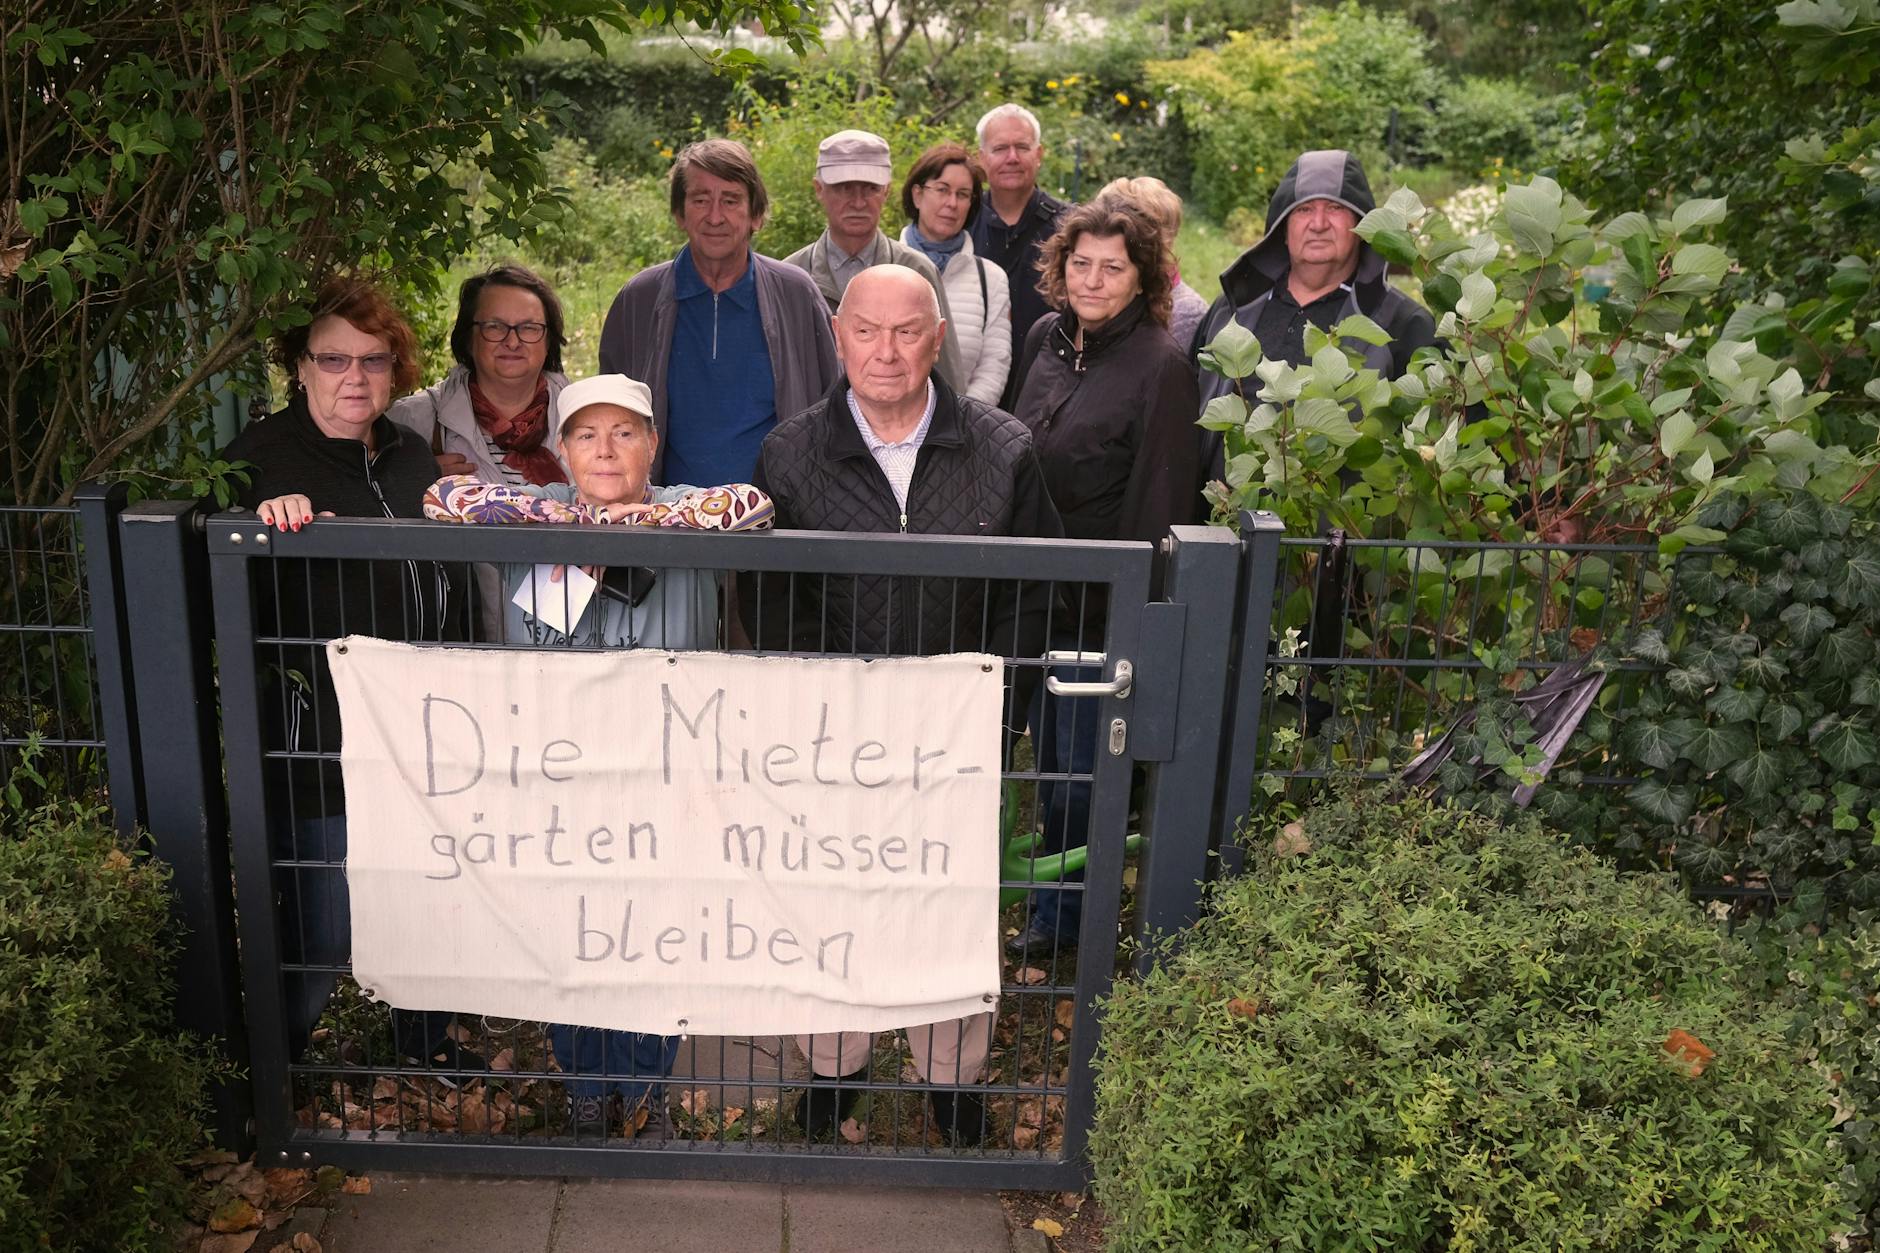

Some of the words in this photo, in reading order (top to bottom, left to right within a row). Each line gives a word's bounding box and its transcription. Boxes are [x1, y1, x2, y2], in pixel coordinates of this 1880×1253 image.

[422, 692, 583, 797] Die
[661, 683, 985, 791] Mieter-
[425, 804, 658, 880] gärten
[722, 814, 950, 876] müssen
[575, 895, 855, 979] bleiben
